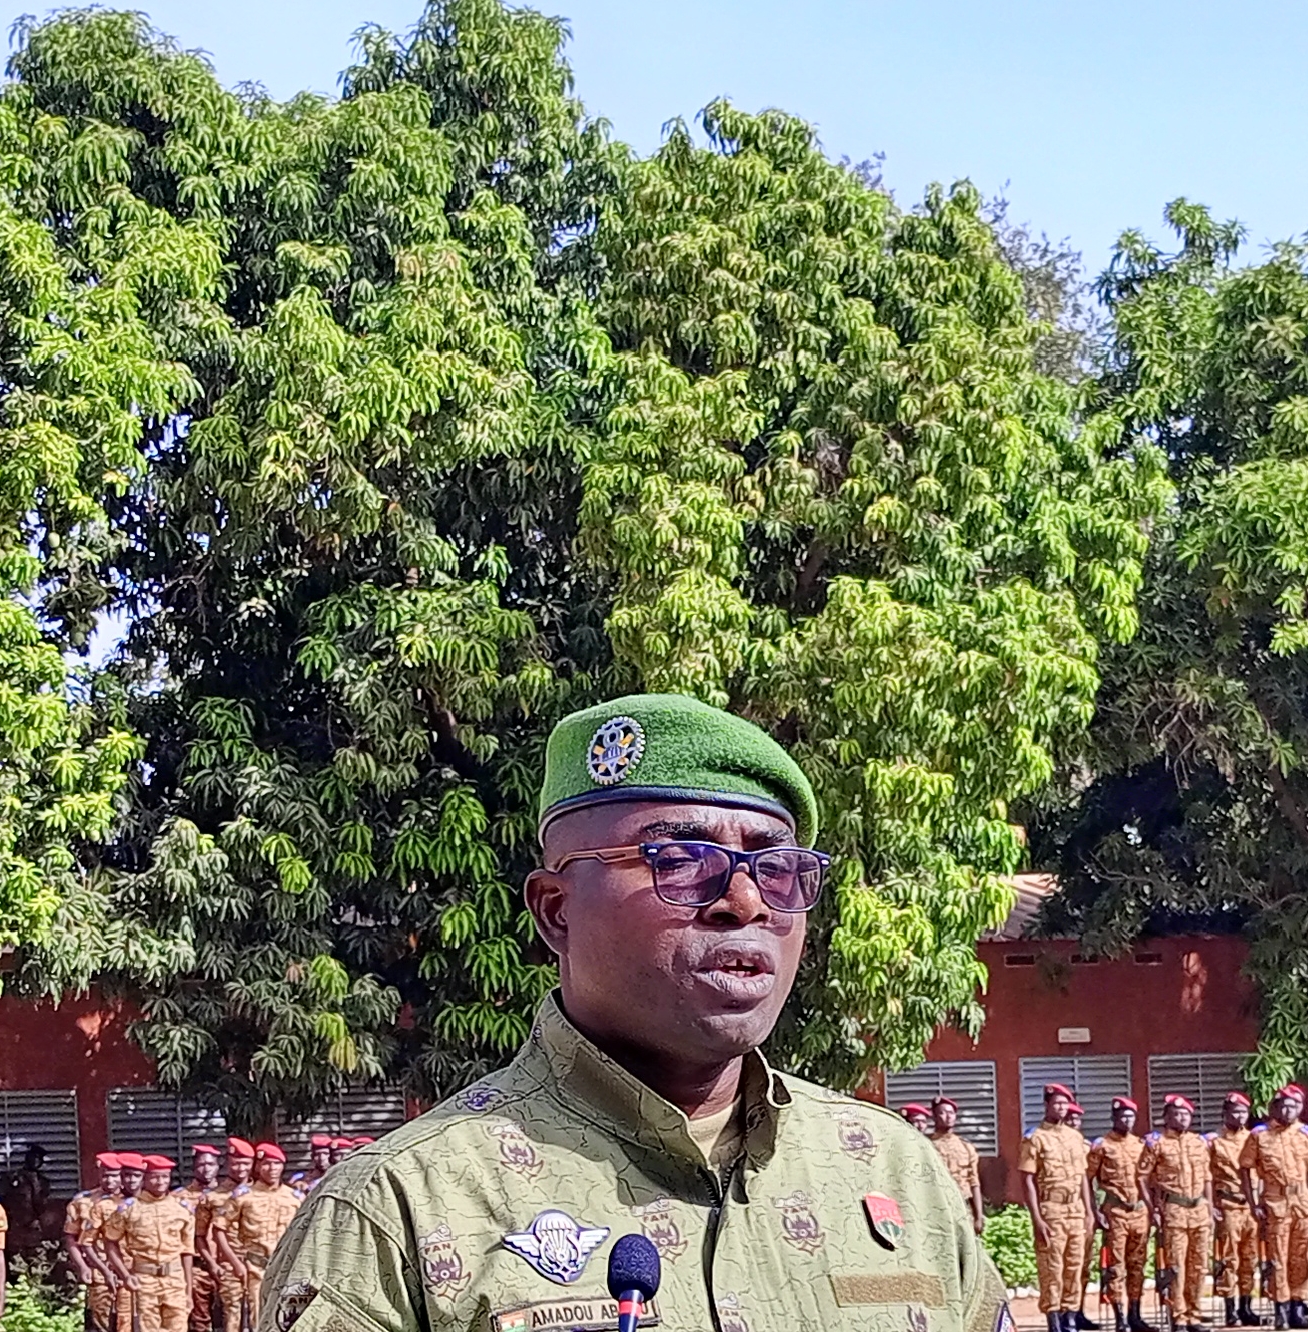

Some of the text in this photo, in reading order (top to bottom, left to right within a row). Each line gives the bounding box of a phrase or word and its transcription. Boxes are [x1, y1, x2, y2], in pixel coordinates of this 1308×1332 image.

[643, 1213, 669, 1222] FAN
[424, 1243, 451, 1255] FAN
[281, 1297, 309, 1305] FAN
[532, 1305, 593, 1327] AMADOU
